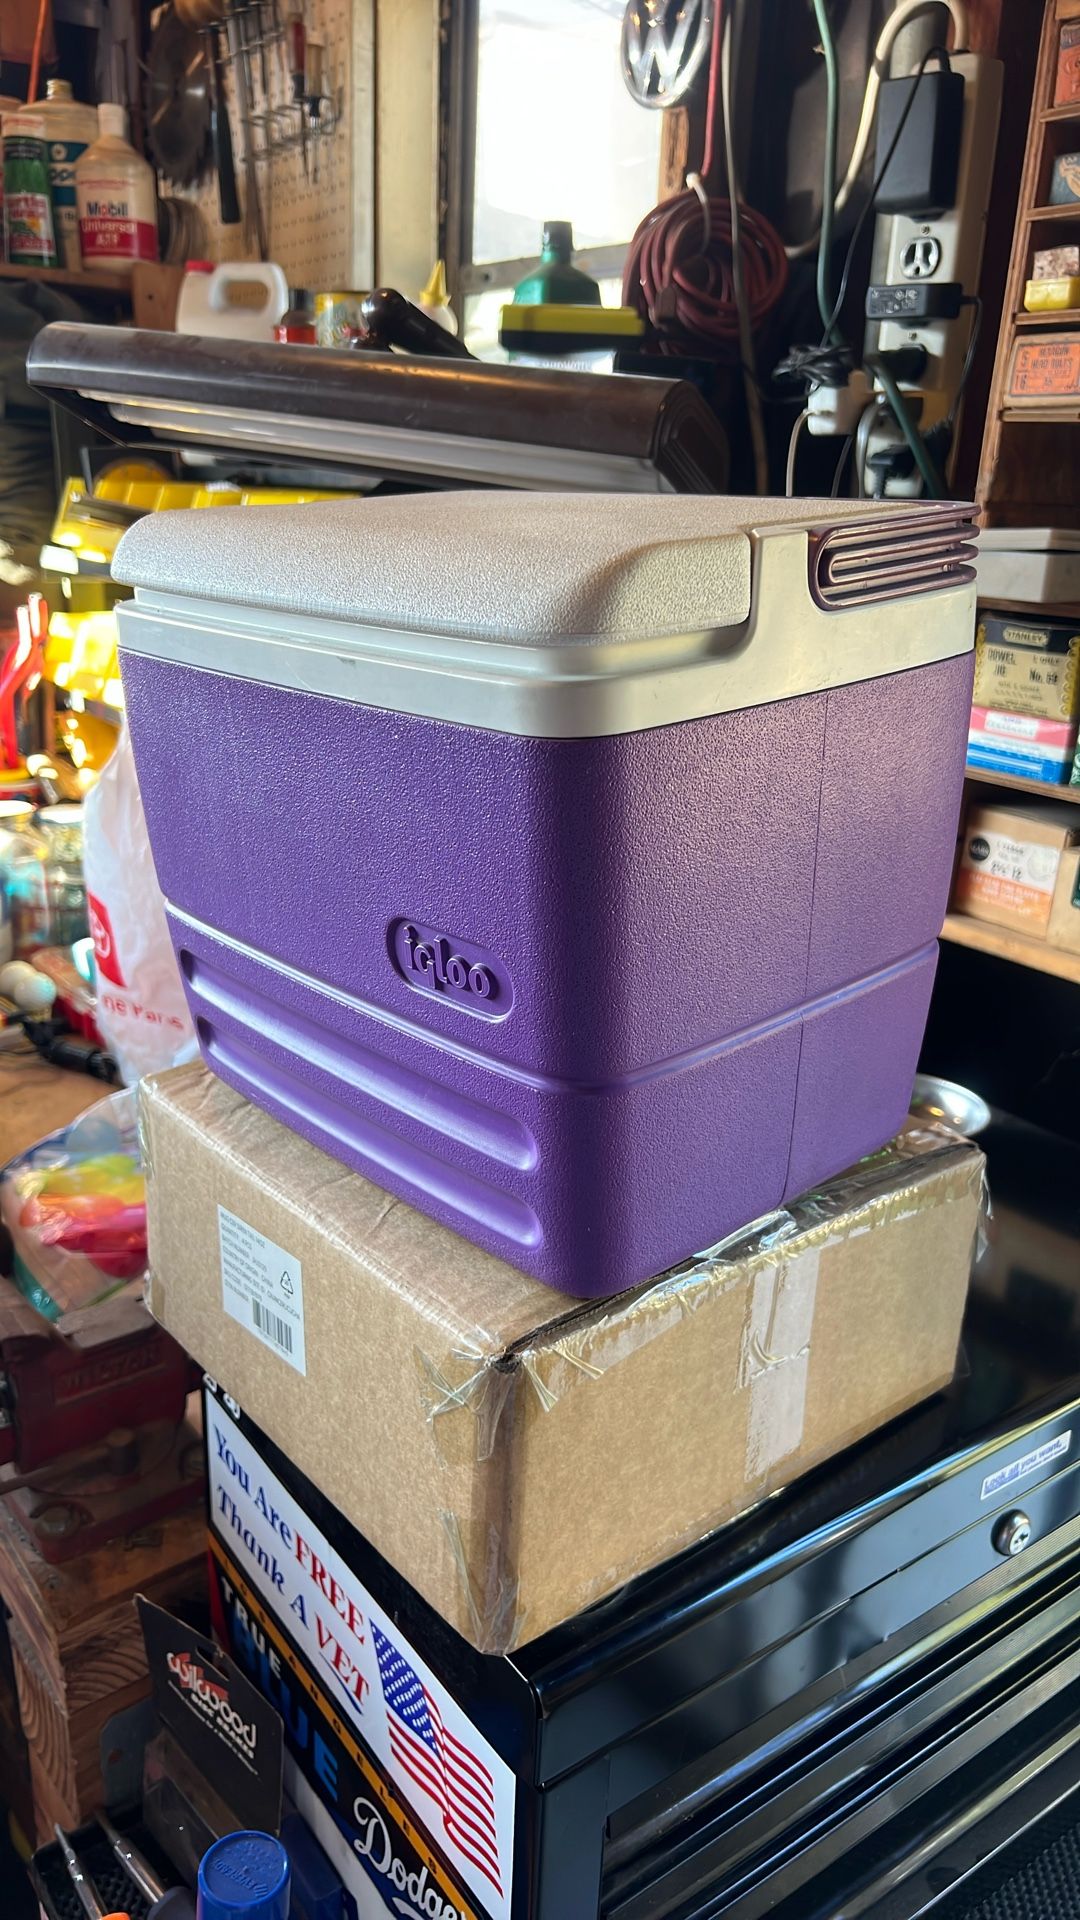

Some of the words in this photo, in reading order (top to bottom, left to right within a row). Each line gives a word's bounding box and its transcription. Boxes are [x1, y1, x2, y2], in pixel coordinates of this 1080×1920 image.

[87, 202, 128, 217] Mobil
[402, 924, 494, 999] igloo
[213, 1422, 252, 1497] You
[254, 1485, 293, 1550] Are
[293, 1527, 365, 1646] FREE
[216, 1484, 286, 1595] Thank
[290, 1593, 309, 1631] A
[315, 1610, 370, 1706] VET
[221, 1575, 282, 1681] TRUE
[166, 1652, 257, 1749] wilwood
